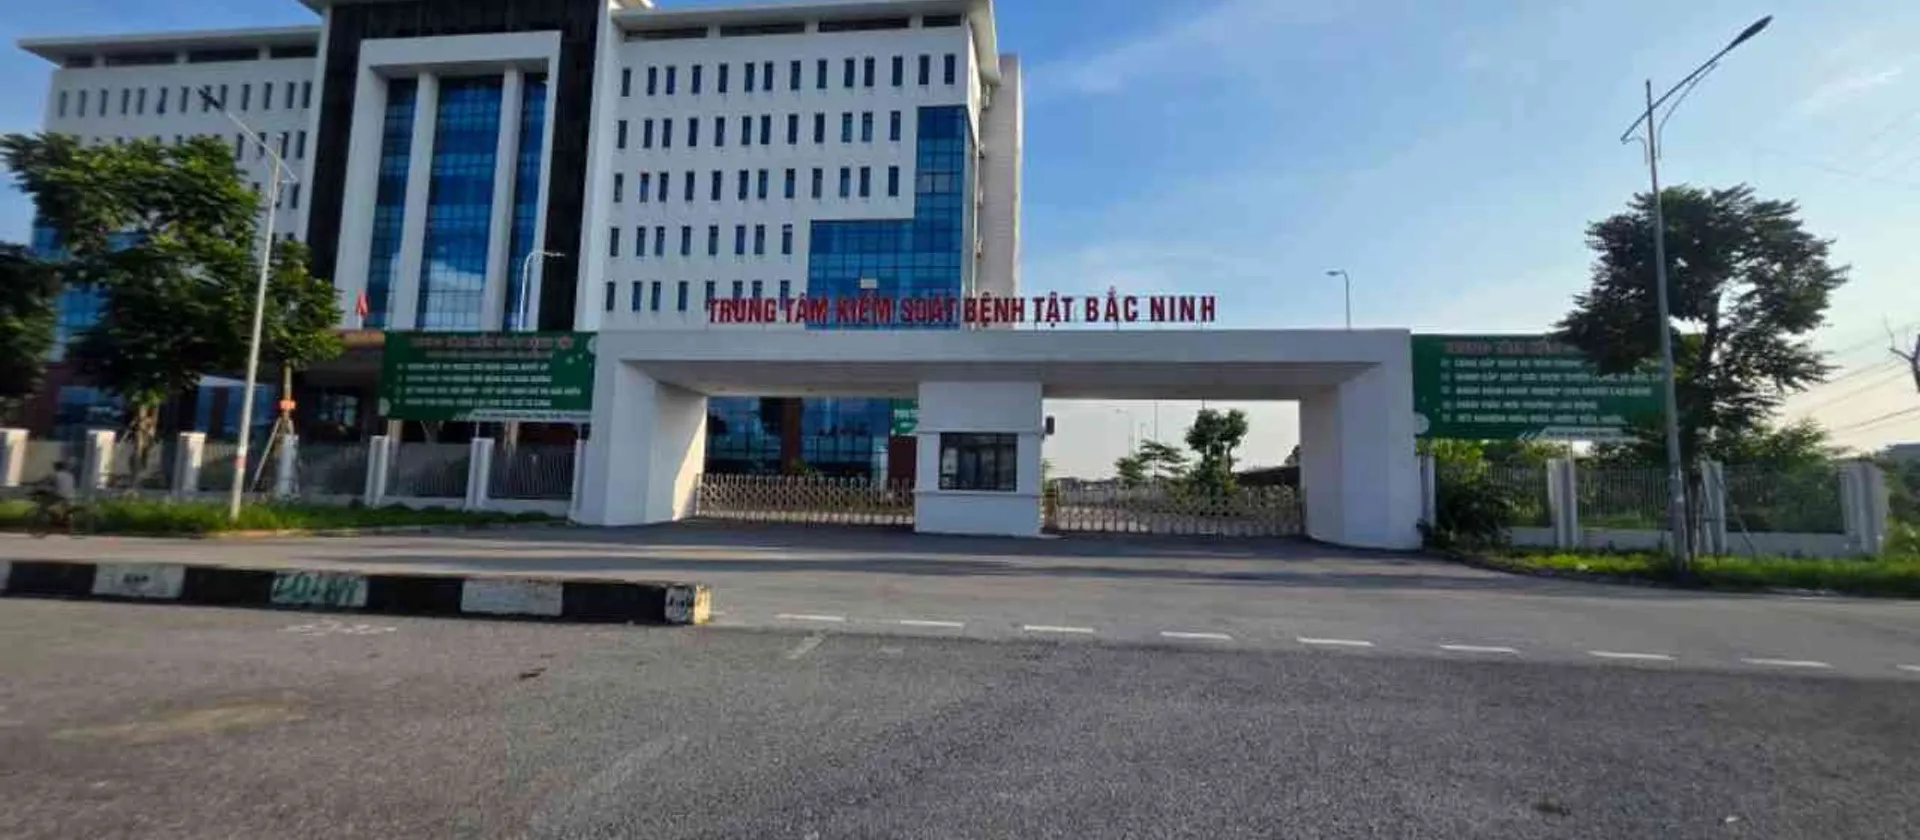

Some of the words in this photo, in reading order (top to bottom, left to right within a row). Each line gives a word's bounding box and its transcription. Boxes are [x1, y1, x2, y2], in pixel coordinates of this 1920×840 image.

[708, 298, 777, 323] TRUNG
[785, 292, 829, 323] TÂM
[963, 292, 1025, 327] BỆNH
[1033, 292, 1074, 327] TẬT
[1085, 285, 1138, 322] BẮC
[1150, 296, 1215, 322] NINH
